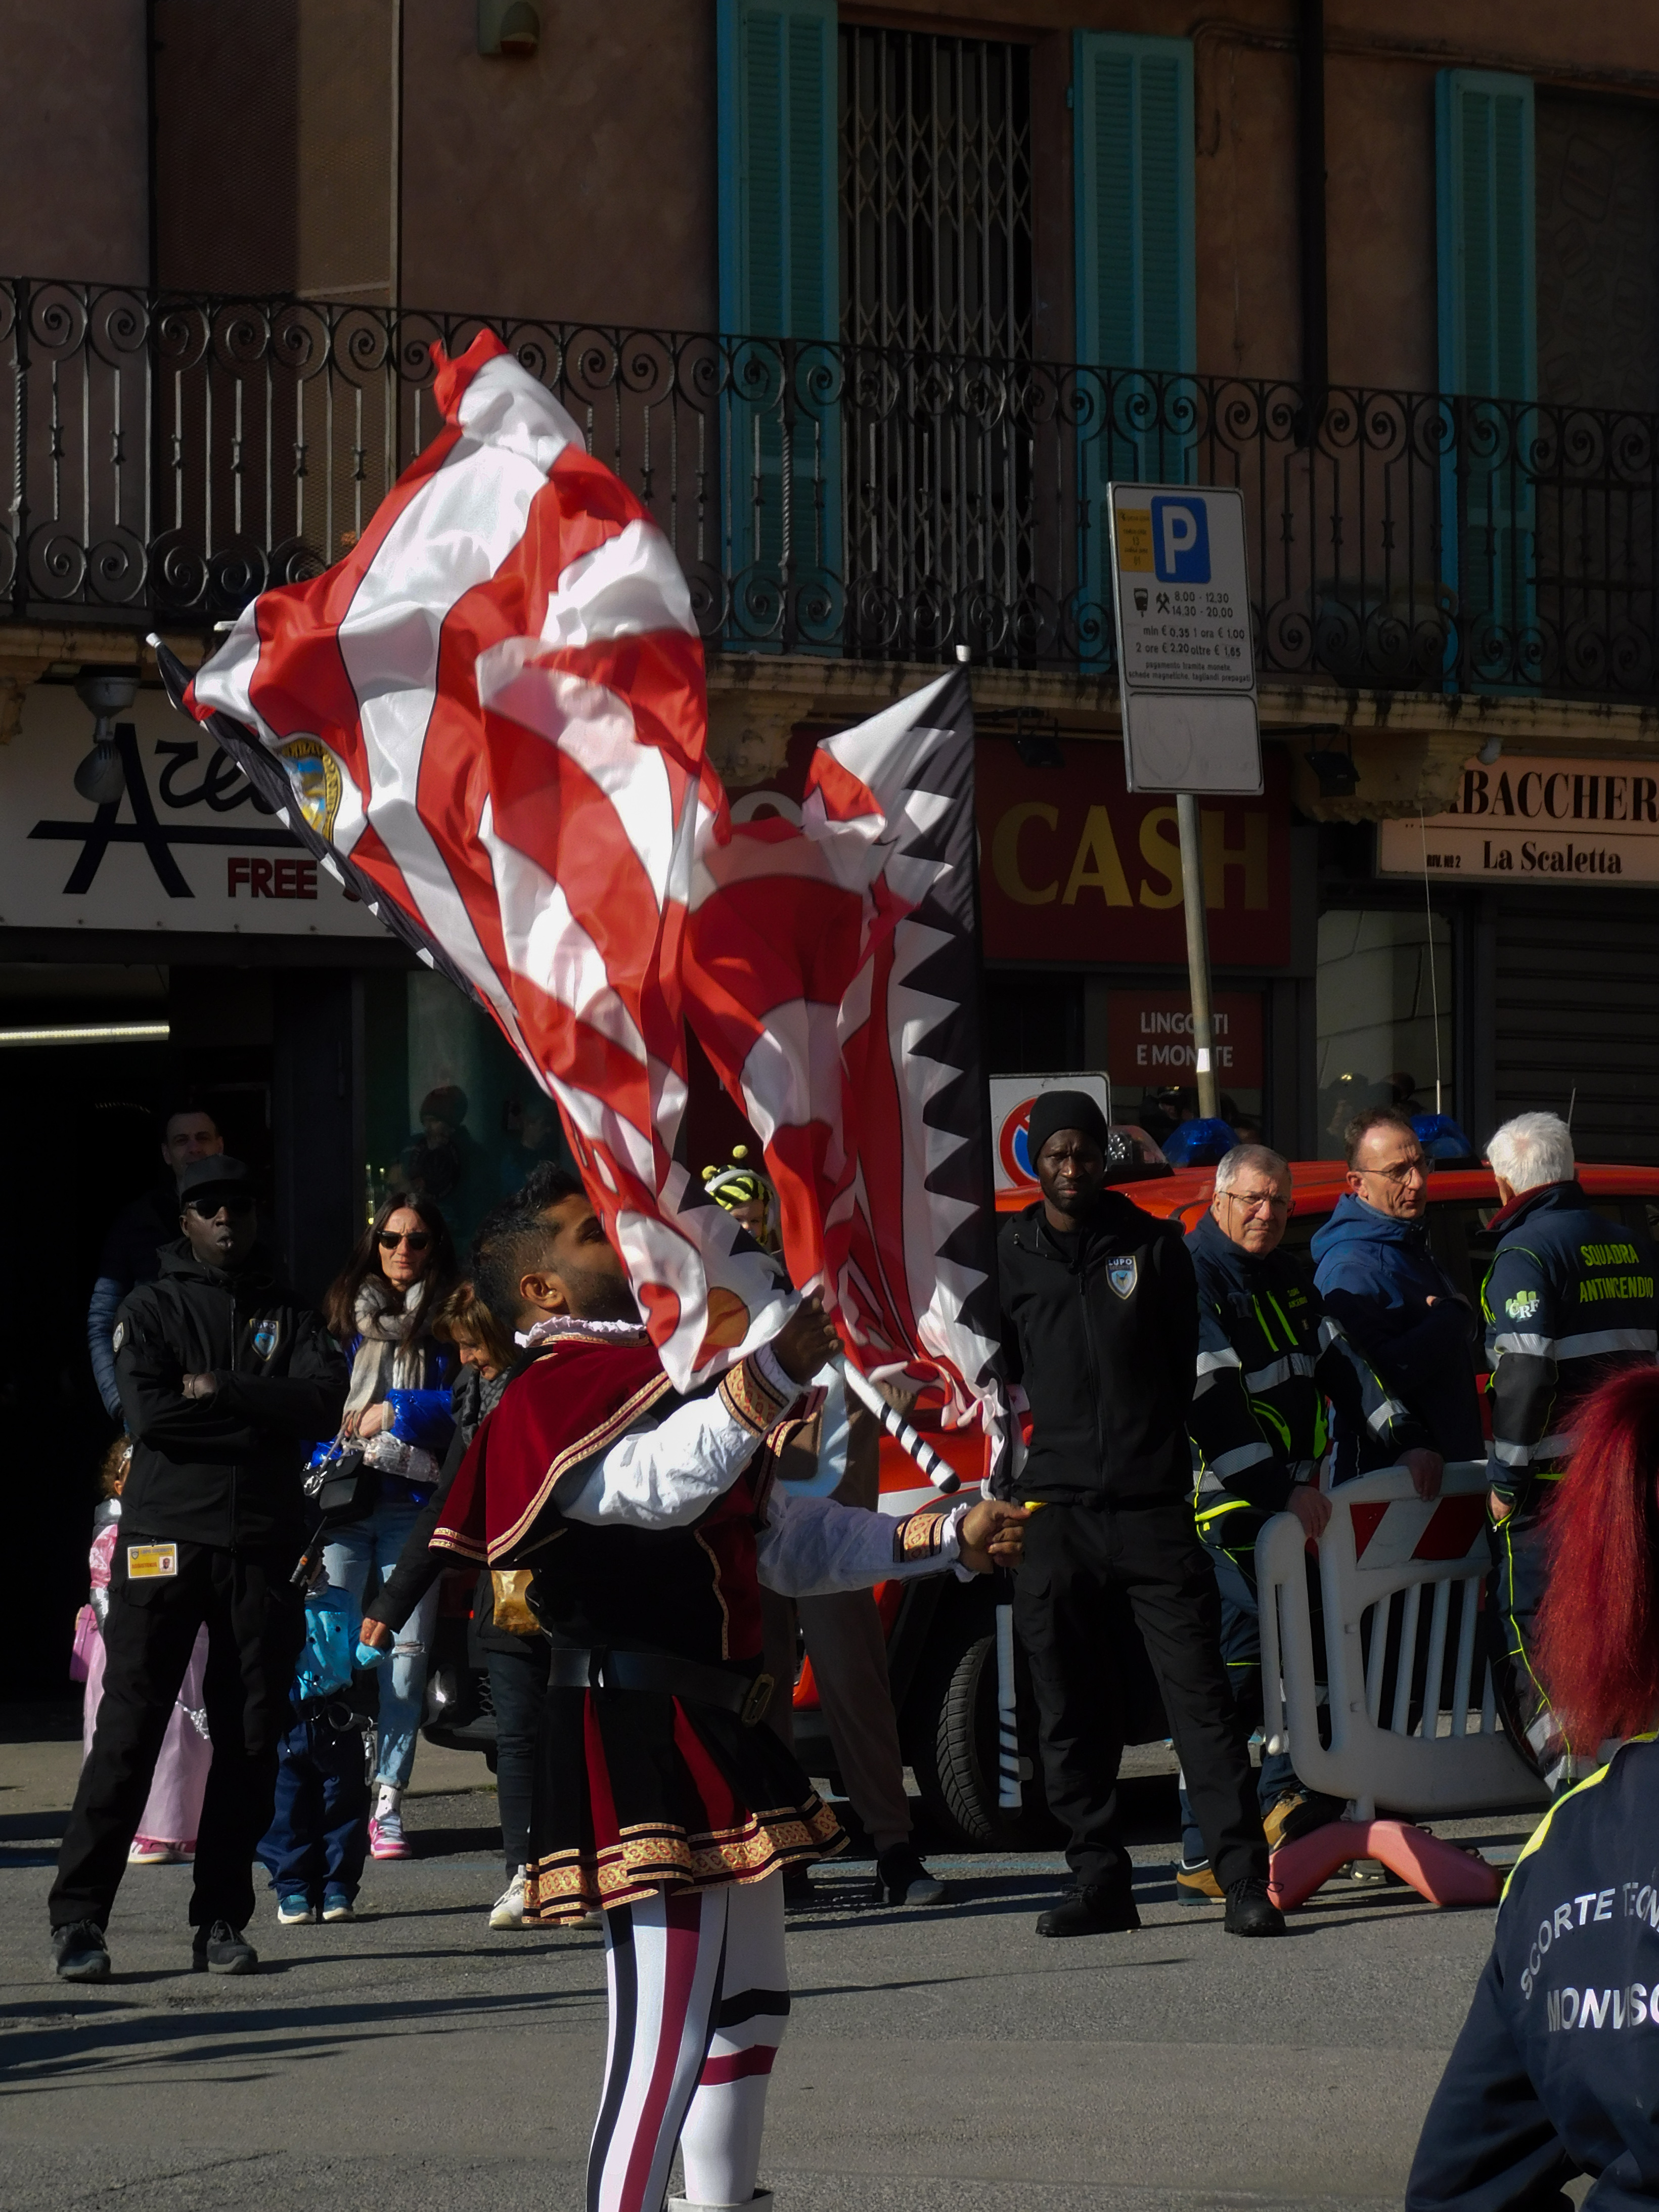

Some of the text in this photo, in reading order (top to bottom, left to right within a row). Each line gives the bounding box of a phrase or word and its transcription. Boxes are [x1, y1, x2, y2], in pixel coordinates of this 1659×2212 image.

[1161, 506, 1197, 574] P
[1143, 626, 1158, 636] min
[1162, 625, 1167, 636] €
[1201, 630, 1215, 639] ora
[1218, 627, 1224, 638] €
[1136, 643, 1141, 652] 2
[1145, 645, 1158, 653] ore
[1162, 642, 1168, 653] €
[1190, 645, 1211, 655] oltre
[1214, 645, 1220, 655] €
[1129, 671, 1150, 679] schede
[1192, 673, 1220, 682] tagliandi
[1222, 674, 1251, 683] prepagati
[1146, 661, 1181, 670] pagamento
[1183, 662, 1205, 670] tramite
[1450, 769, 1659, 822] BACCHER
[992, 801, 1269, 910] CASH
[1455, 855, 1461, 868] 2
[1484, 840, 1513, 870] La
[1521, 840, 1623, 874] Scaletta
[228, 857, 318, 899] FREE
[1141, 1011, 1228, 1035] LINGOTI
[1137, 1044, 1233, 1068] E MONTE
[1580, 1244, 1640, 1266] SQUADRA
[1579, 1276, 1654, 1303] ANTINCENDIO
[1509, 1299, 1540, 1319] CRF
[1520, 1882, 1659, 2000] SCORTE TECN
